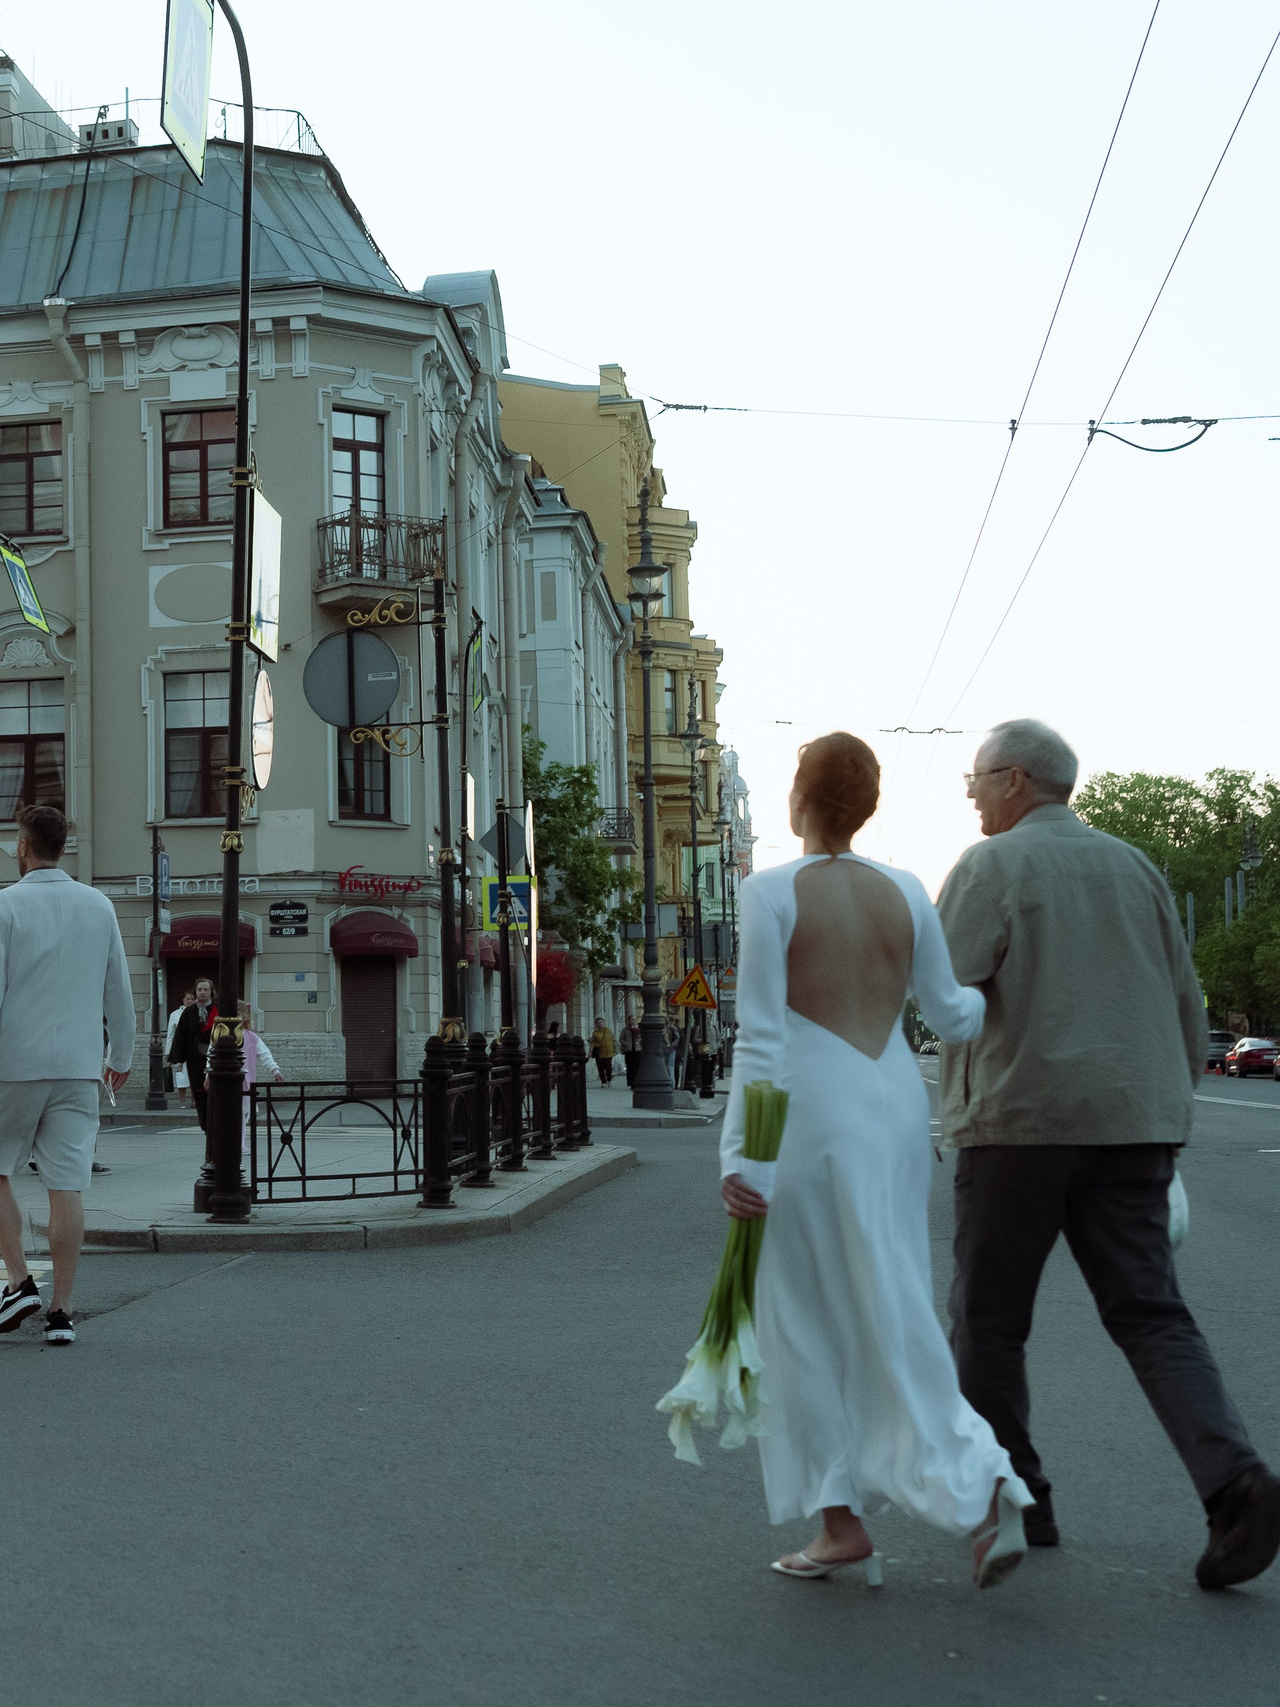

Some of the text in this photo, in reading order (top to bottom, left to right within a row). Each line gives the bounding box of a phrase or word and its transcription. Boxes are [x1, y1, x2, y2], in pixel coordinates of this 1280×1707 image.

[136, 876, 260, 896] Внотеа
[338, 865, 422, 899] Vinissimo
[177, 935, 219, 950] Vinissimo
